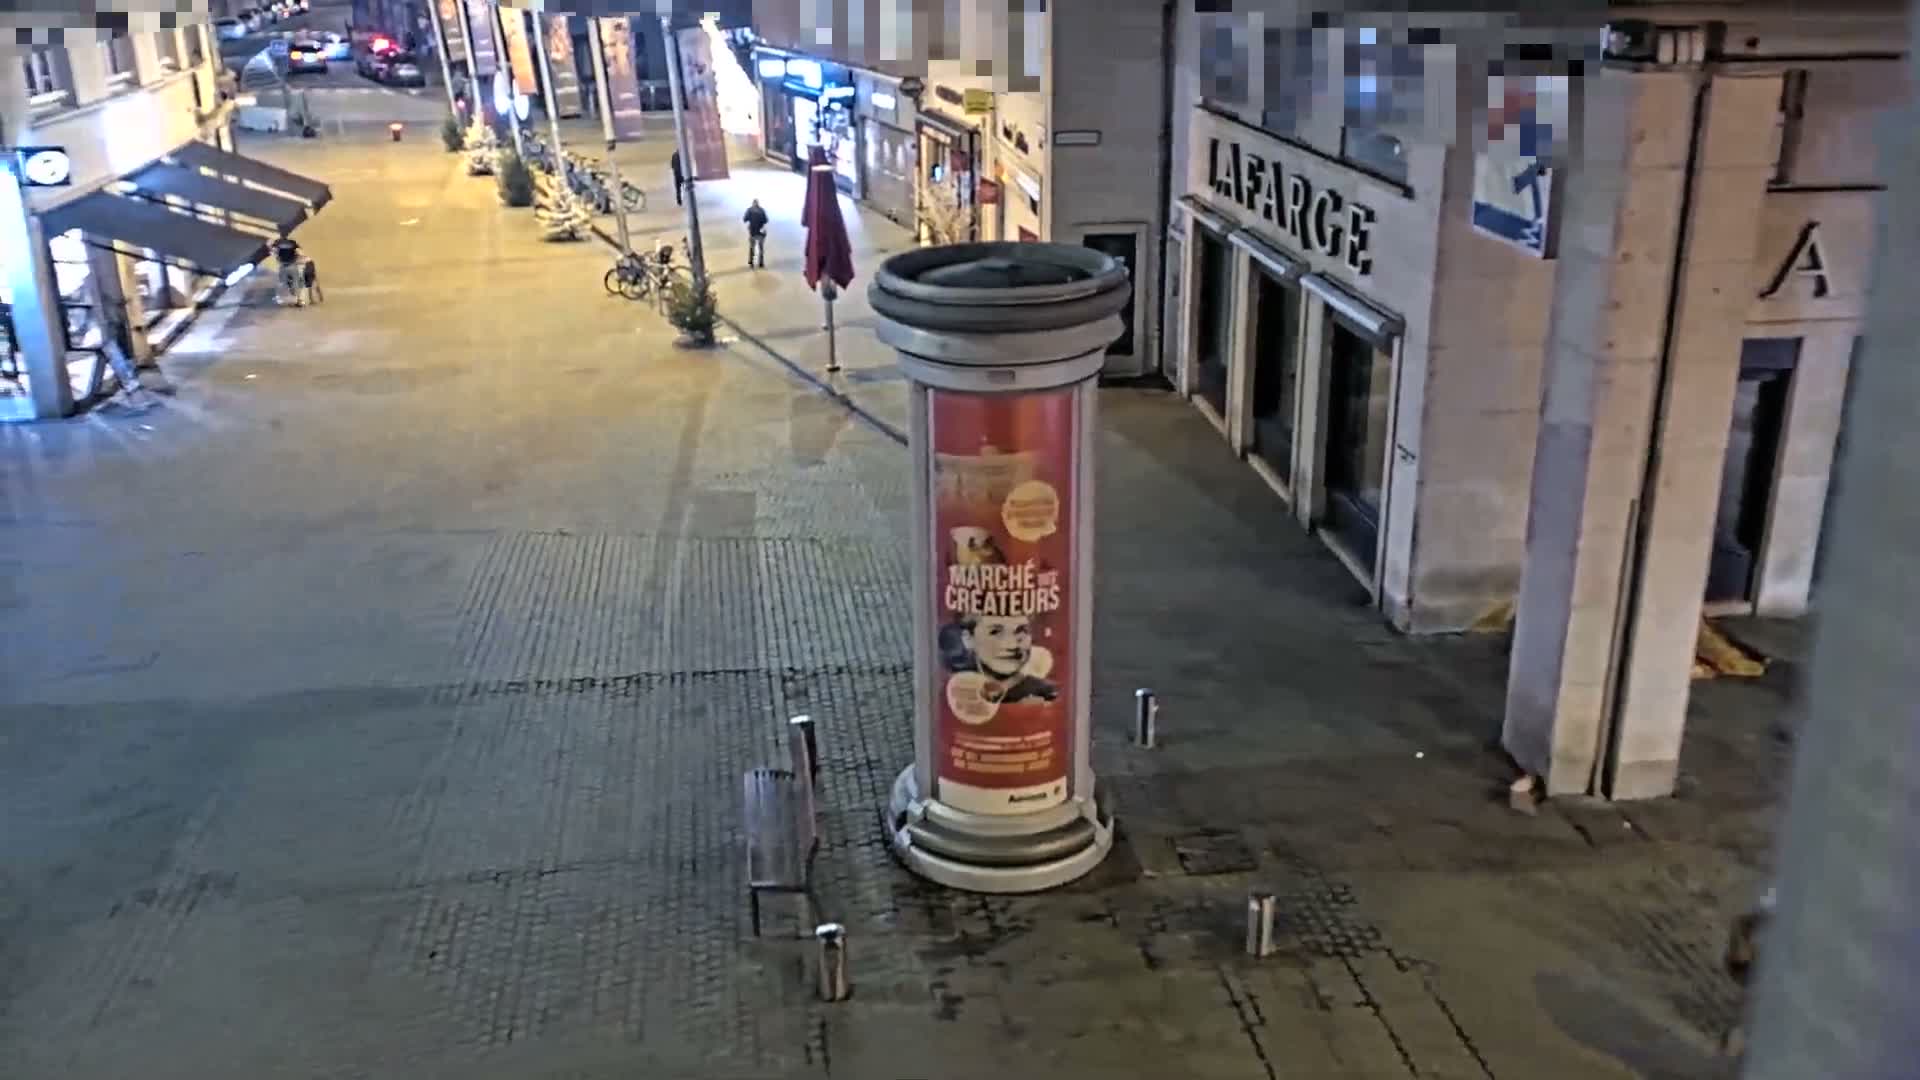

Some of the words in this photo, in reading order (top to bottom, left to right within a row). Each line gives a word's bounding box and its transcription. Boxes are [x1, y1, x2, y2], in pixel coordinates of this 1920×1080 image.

[1208, 138, 1377, 277] LAFARGE
[1757, 219, 1832, 299] A
[949, 558, 1035, 591] MARCHÉ
